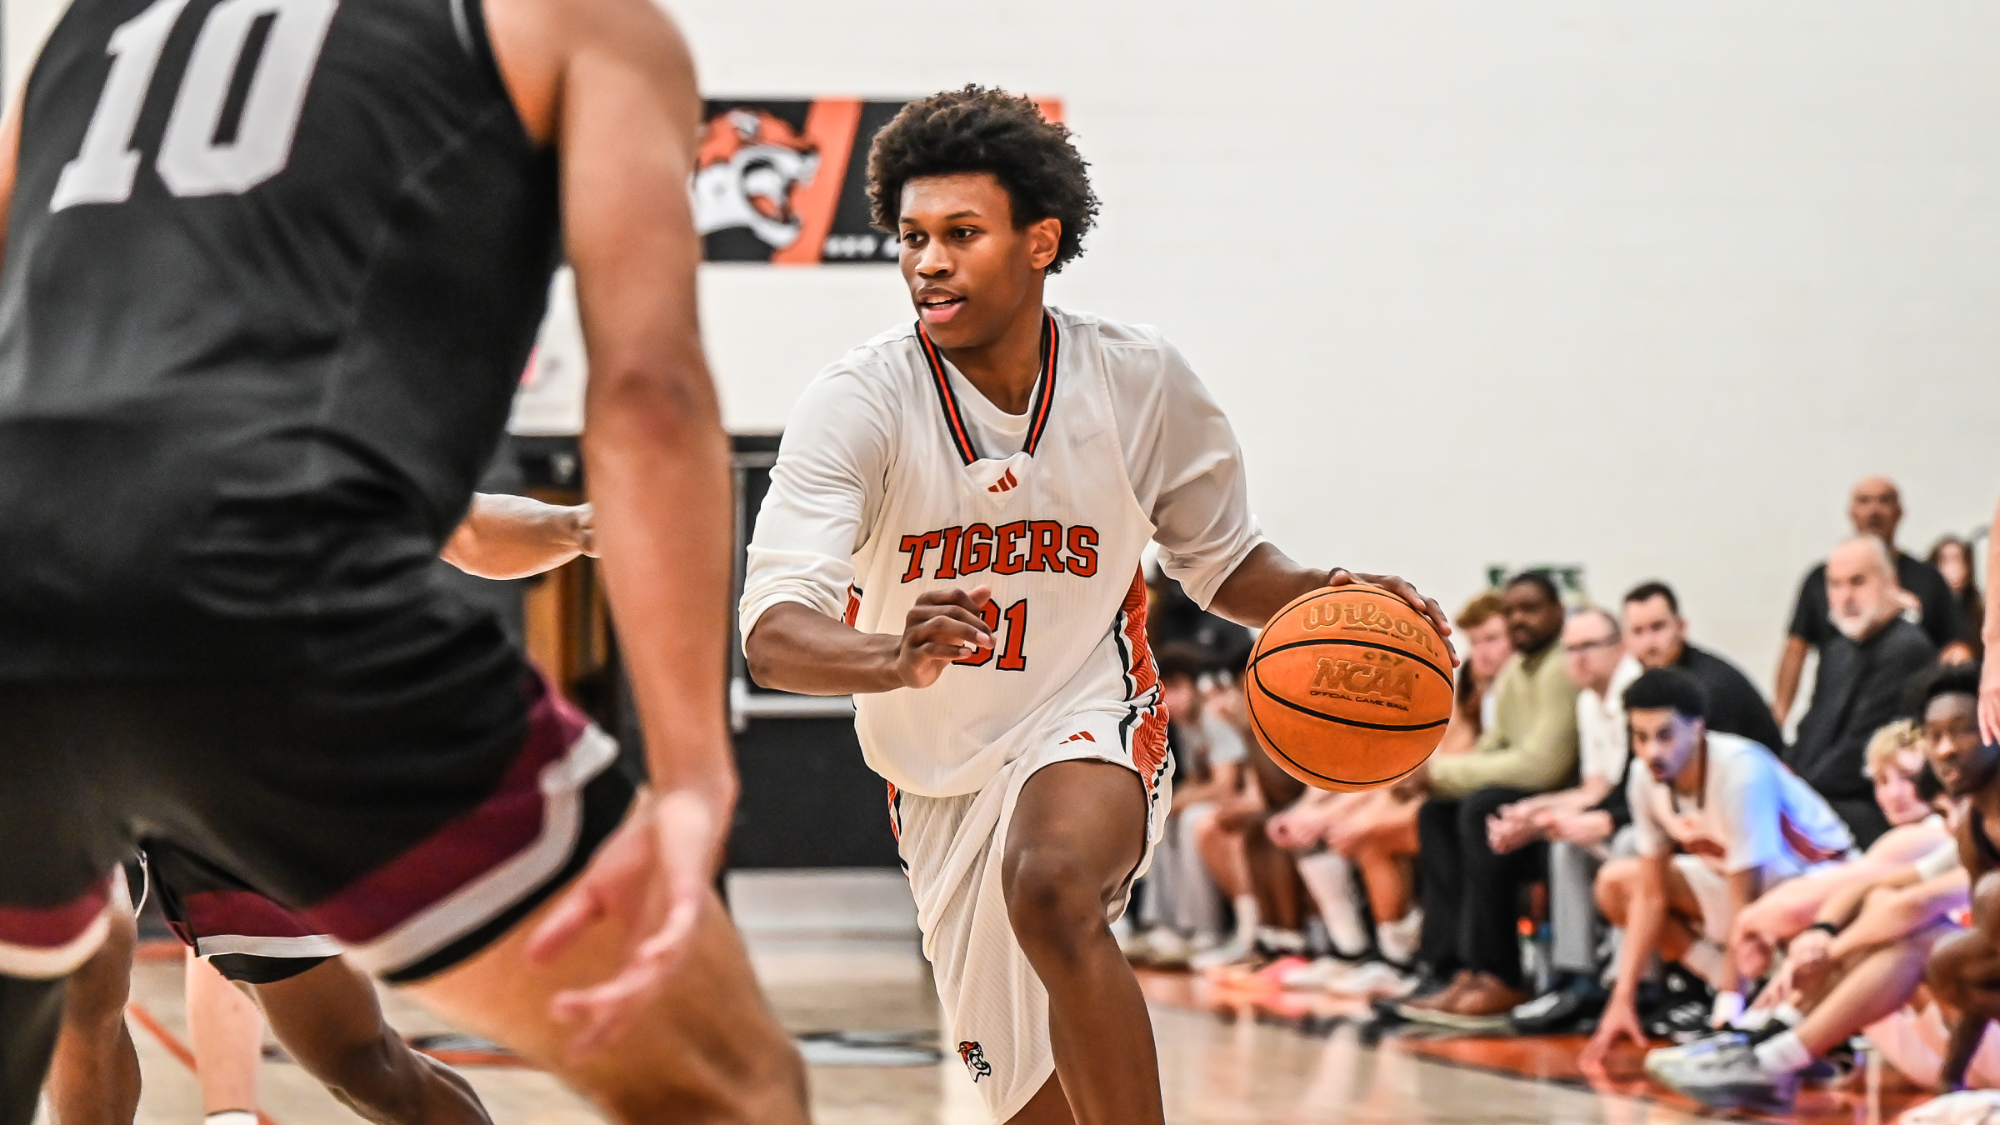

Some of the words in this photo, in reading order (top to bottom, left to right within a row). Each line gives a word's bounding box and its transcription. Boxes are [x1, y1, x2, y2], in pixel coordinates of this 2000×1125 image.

[50, 0, 340, 213] 10
[898, 520, 1099, 583] TIGERS
[1301, 601, 1434, 654] Wilson
[1310, 690, 1353, 702] OFFICIAL
[1386, 701, 1410, 712] BALL
[1311, 657, 1412, 702] NCAA
